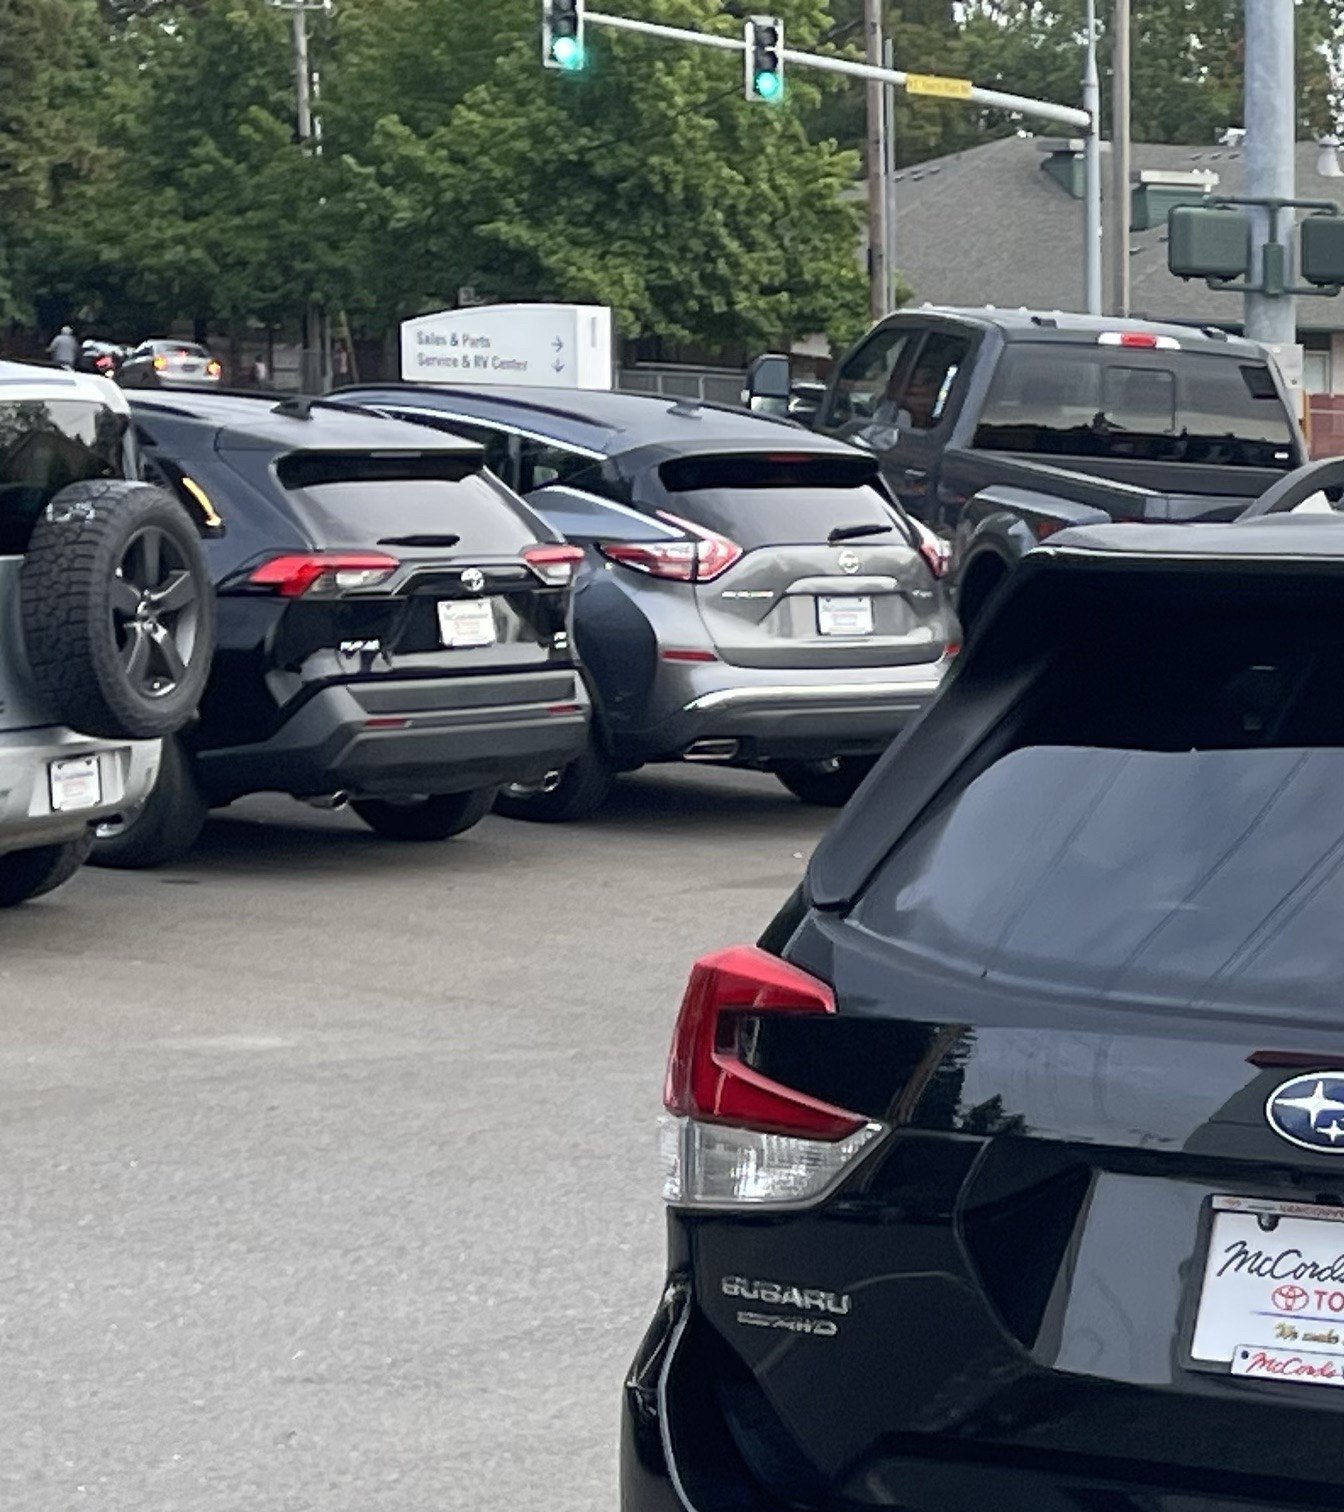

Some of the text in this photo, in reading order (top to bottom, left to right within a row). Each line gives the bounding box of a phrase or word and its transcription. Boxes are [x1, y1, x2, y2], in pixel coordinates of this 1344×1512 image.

[416, 331, 491, 349] Sales & Parts
[416, 352, 458, 368] Service
[491, 356, 528, 372] Center
[721, 1275, 851, 1315] SUBARU
[1245, 1351, 1342, 1380] McCords
